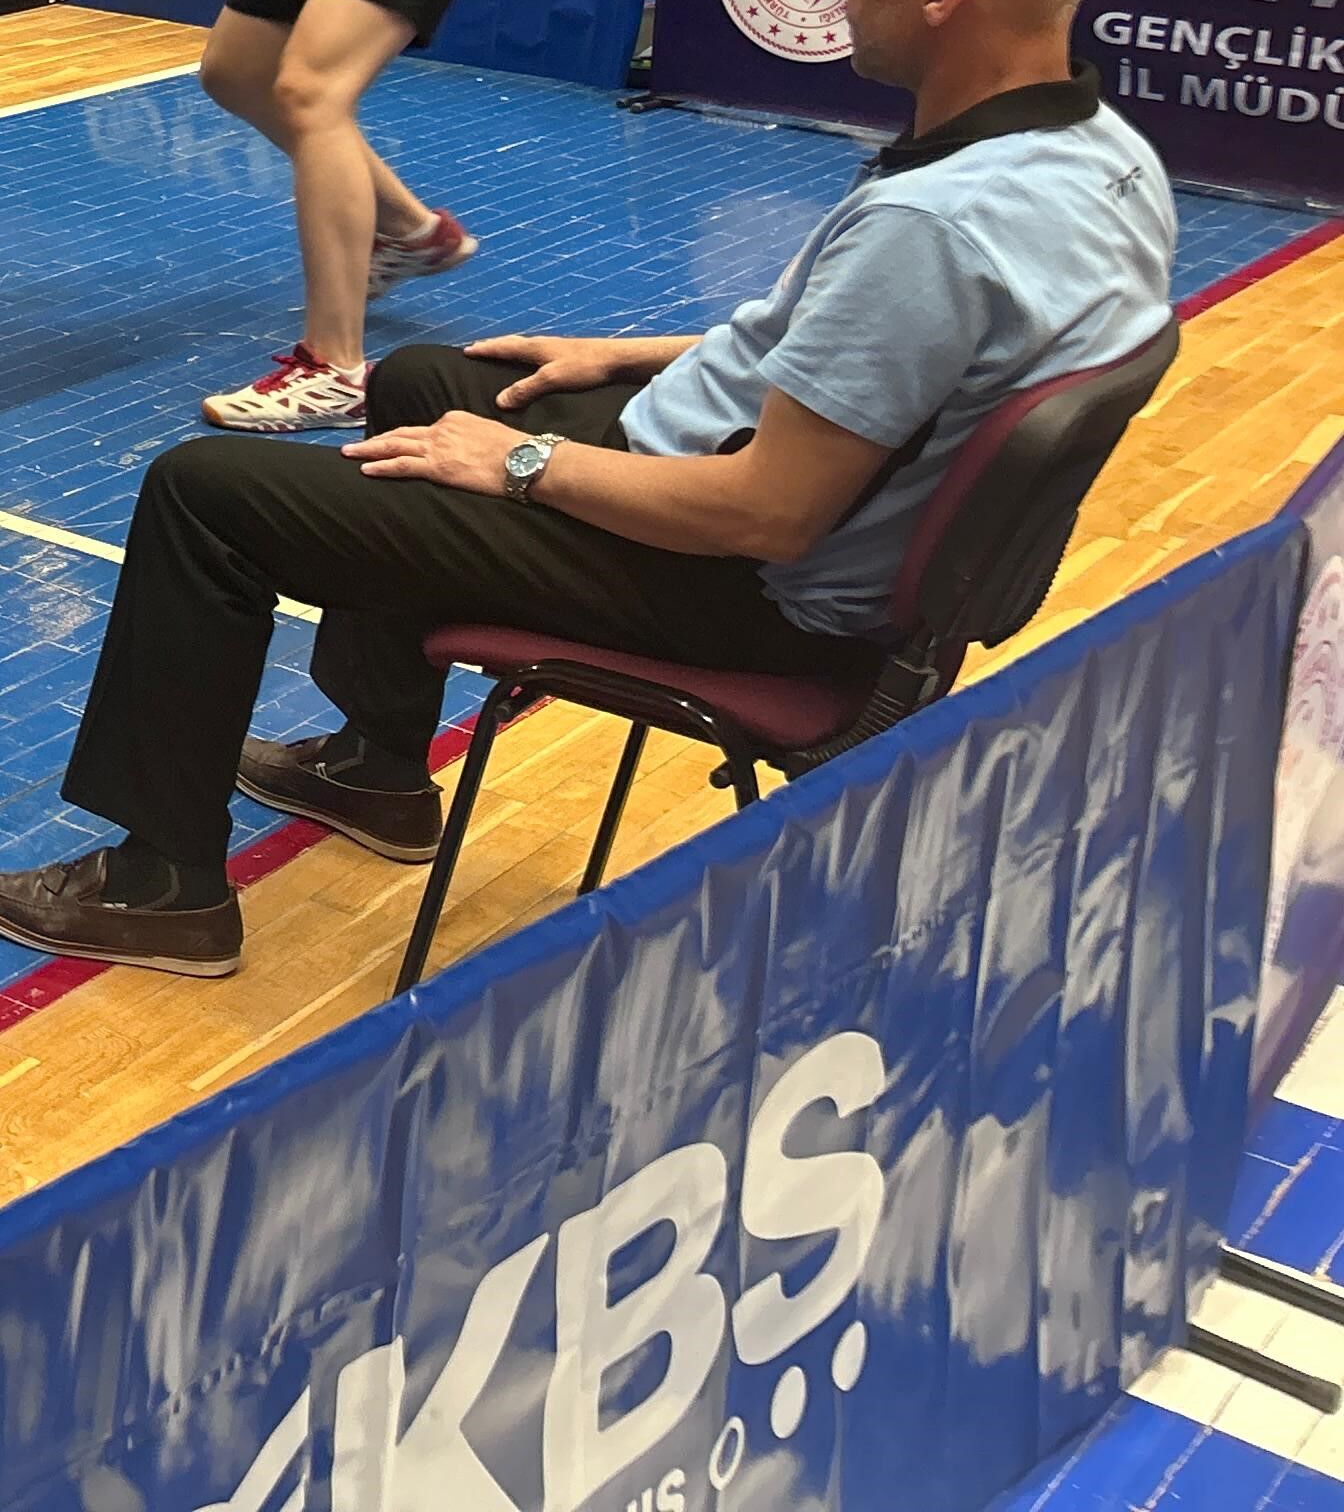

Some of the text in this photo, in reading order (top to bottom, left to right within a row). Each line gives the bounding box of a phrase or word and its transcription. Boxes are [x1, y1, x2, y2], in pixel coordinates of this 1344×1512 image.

[1092, 11, 1344, 74] GENÇLİK
[1118, 58, 1165, 101] İL
[330, 1031, 886, 1512] KBS
